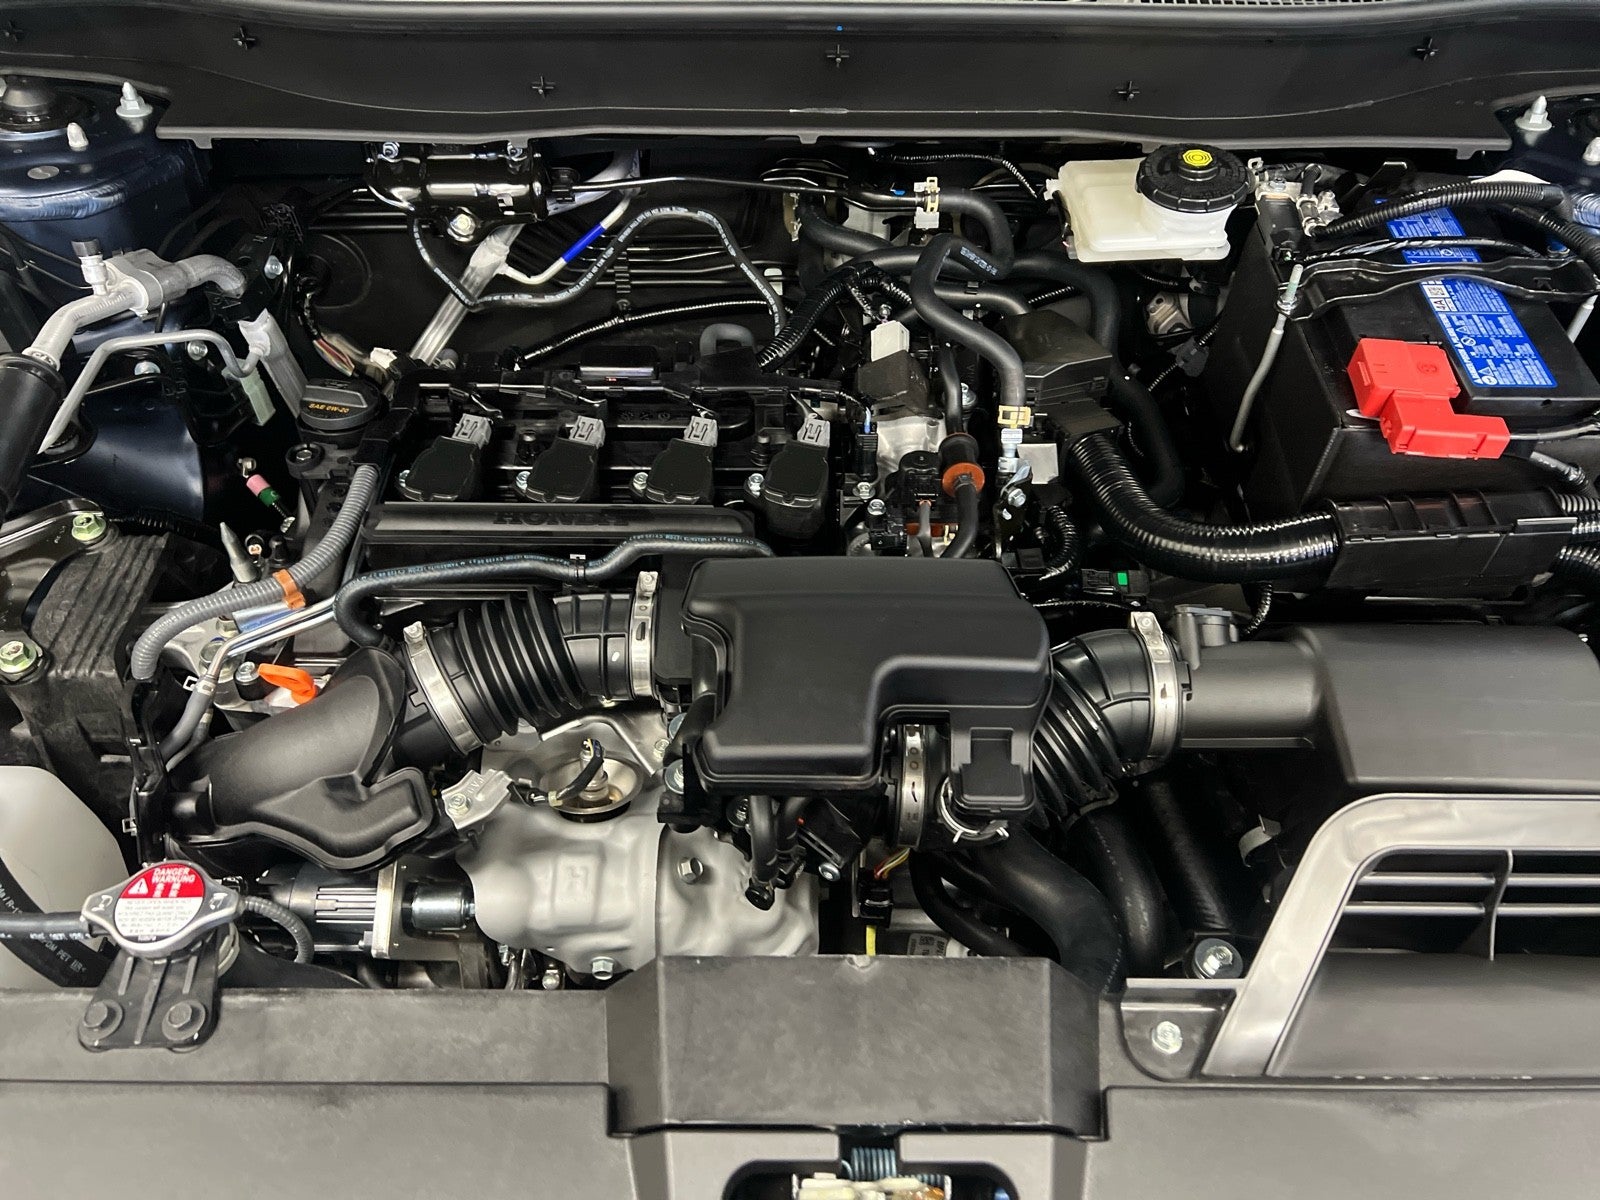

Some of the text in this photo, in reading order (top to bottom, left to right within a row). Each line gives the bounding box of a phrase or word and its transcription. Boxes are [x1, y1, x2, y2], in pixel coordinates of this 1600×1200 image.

[326, 405, 350, 413] 0W-20
[493, 511, 629, 526] HONDA
[153, 867, 190, 876] DANGER
